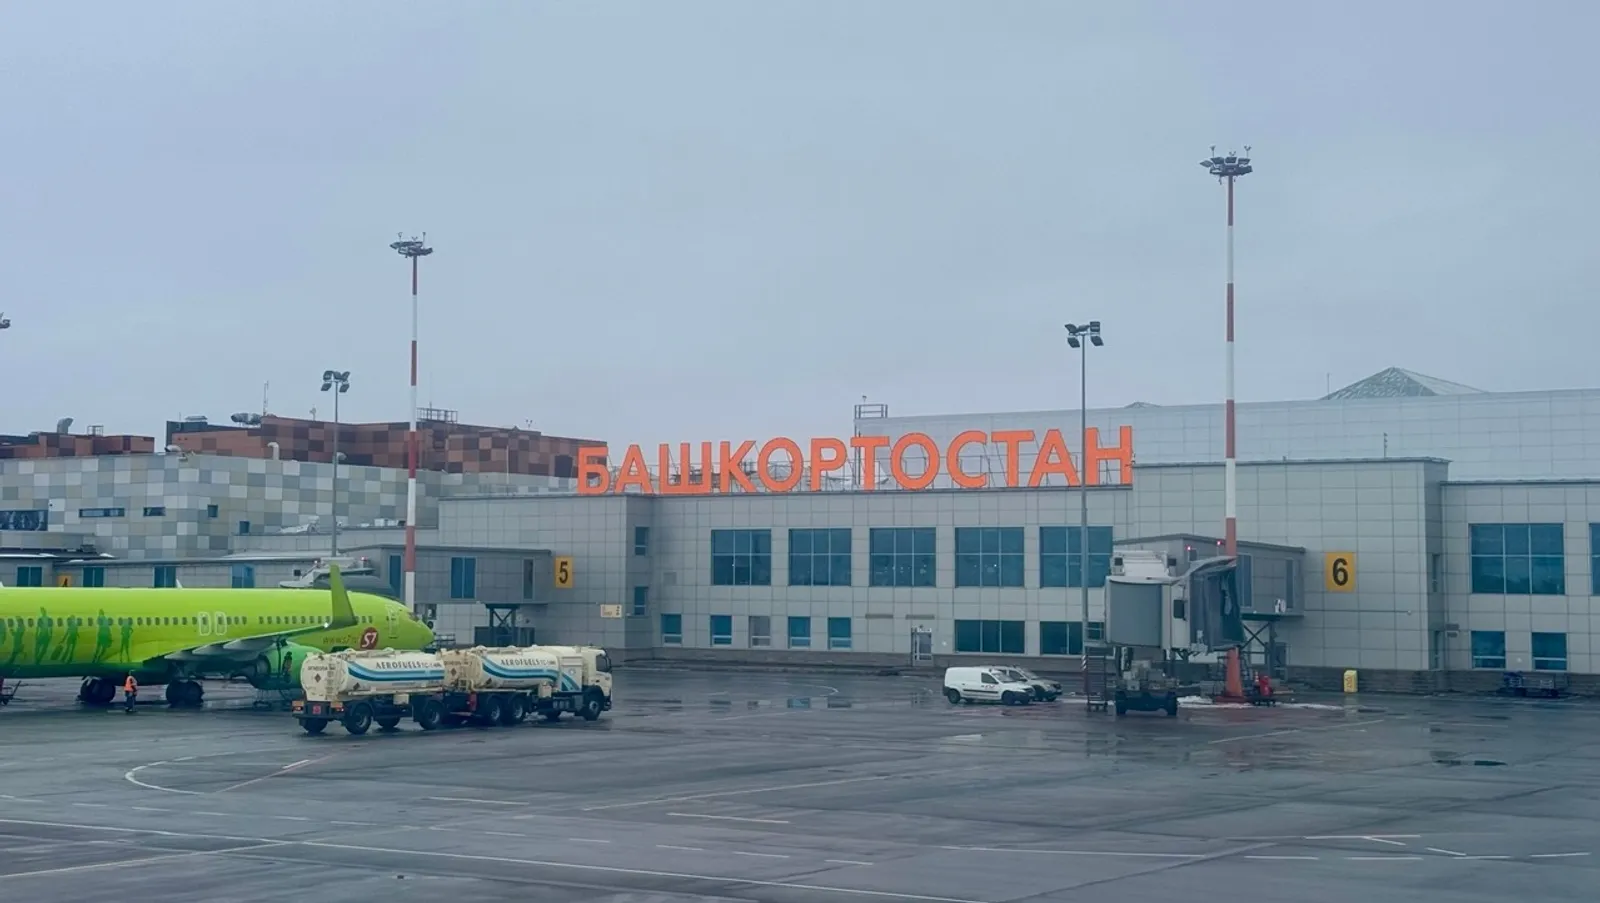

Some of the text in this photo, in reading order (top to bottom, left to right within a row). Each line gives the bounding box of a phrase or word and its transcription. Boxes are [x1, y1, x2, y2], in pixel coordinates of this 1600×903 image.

[577, 426, 1134, 495] БАШКОРТОСТАН
[559, 560, 568, 584] 5
[1332, 557, 1349, 586] 6
[361, 632, 377, 648] S7
[376, 661, 421, 669] AEROFUELS
[501, 659, 540, 667] AEROFUELS
